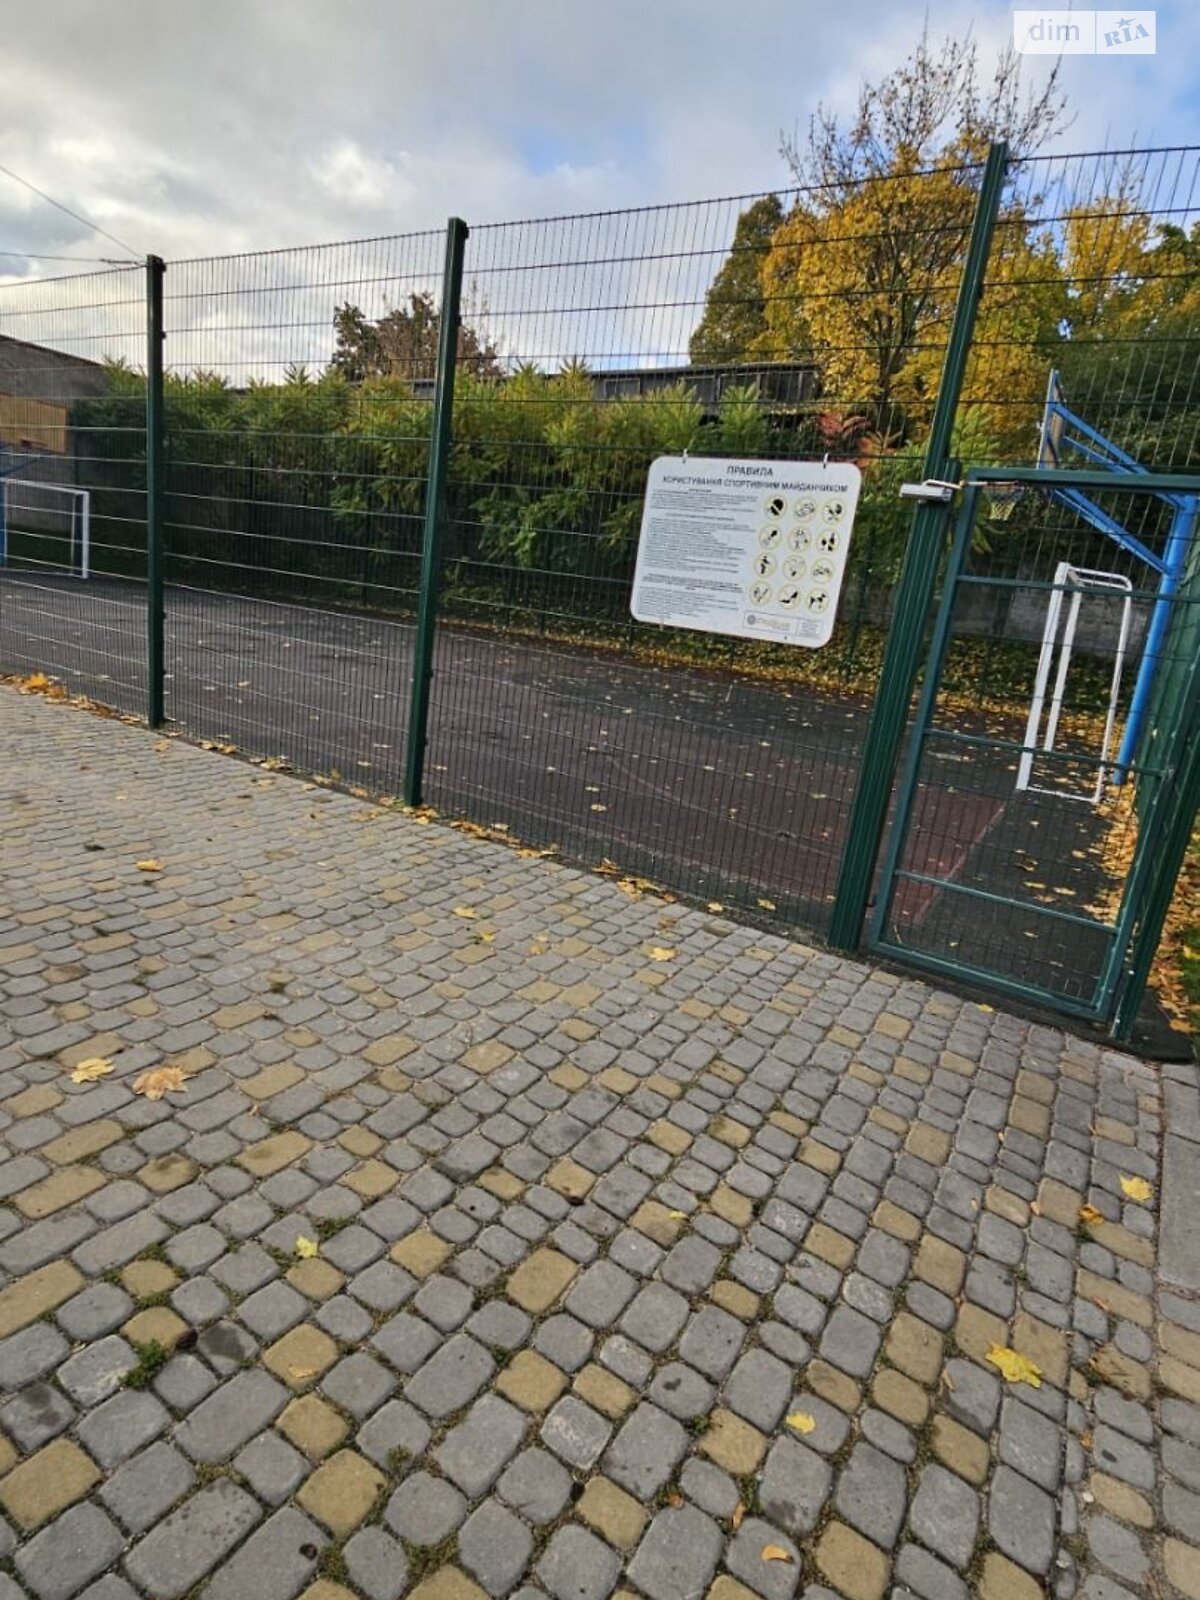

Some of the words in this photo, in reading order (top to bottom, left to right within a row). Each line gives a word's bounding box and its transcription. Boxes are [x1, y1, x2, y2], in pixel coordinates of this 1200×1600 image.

[727, 465, 773, 476] ПРАВИЛА
[663, 475, 722, 486] КОРИСТУВАННЯ
[724, 479, 780, 489] СПОРТИВНИМ
